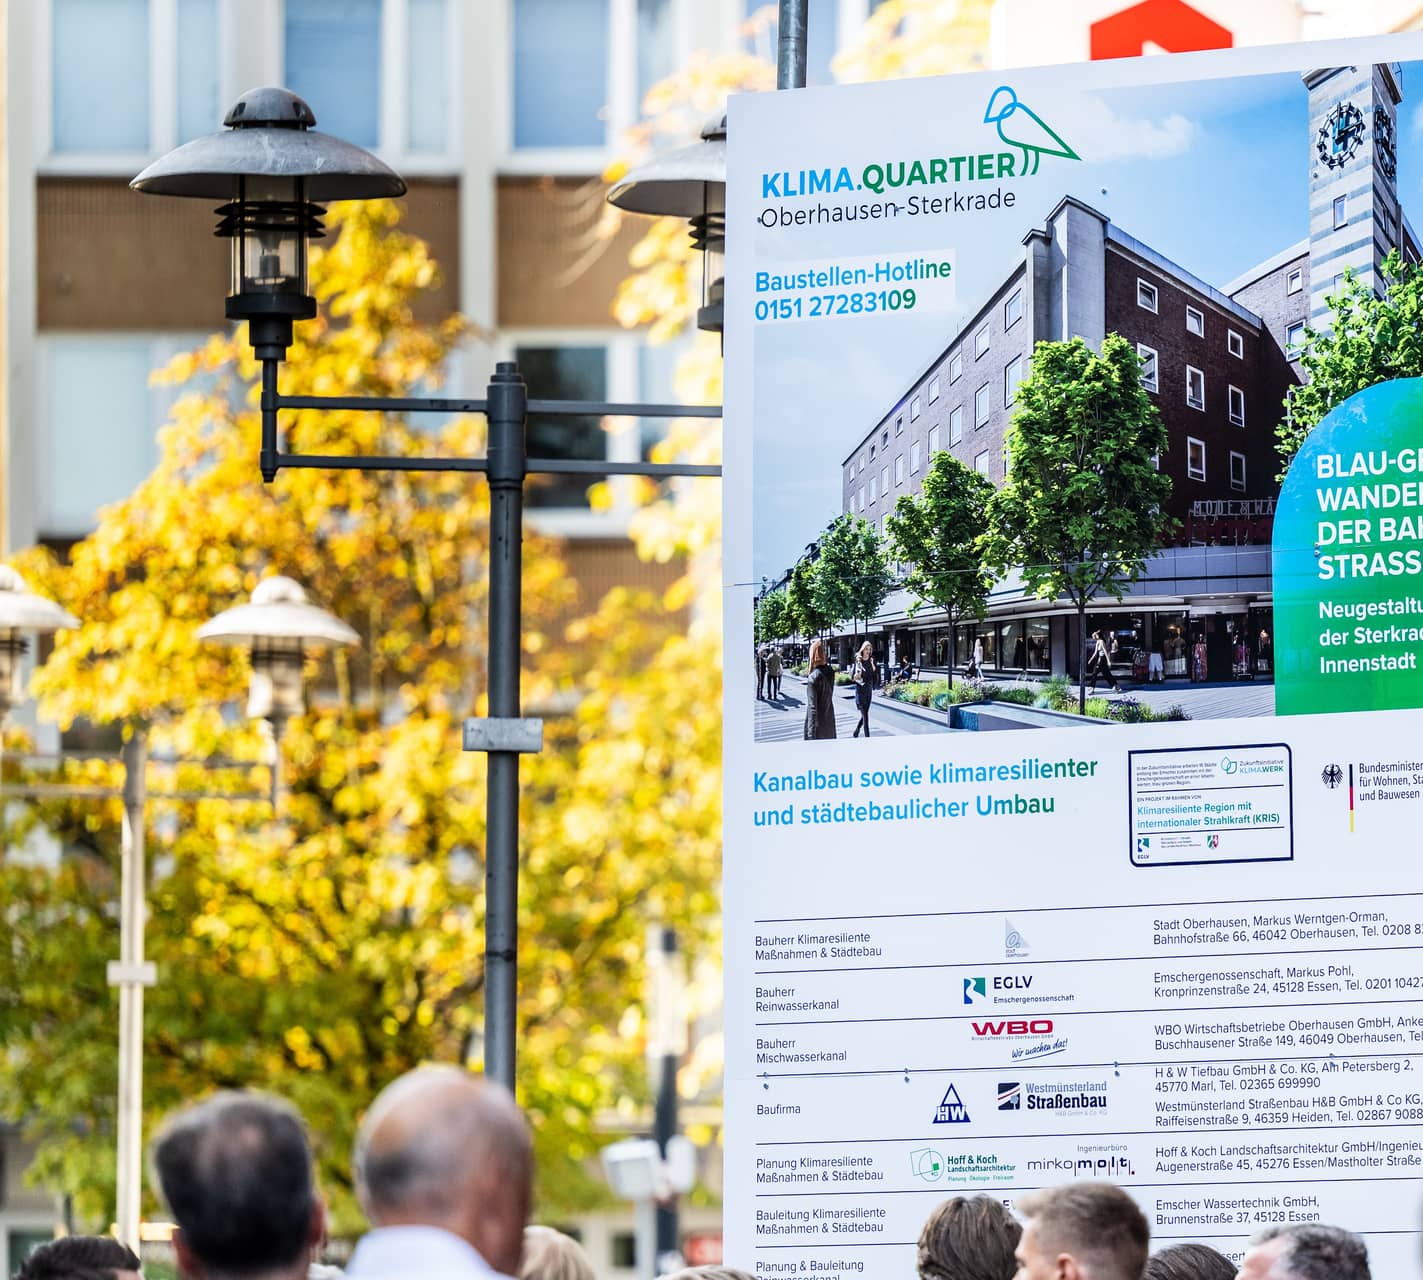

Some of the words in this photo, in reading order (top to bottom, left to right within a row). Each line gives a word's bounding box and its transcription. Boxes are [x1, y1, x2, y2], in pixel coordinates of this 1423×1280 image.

[762, 152, 1015, 198] KLIMA.QUARTIER
[761, 188, 1016, 228] Oberhausen-Sterkrade
[755, 258, 951, 292] Baustellen-Hotline
[755, 299, 802, 320] 0151
[809, 289, 917, 317] 27283109
[1318, 520, 1371, 547] DER
[1319, 628, 1349, 646] der
[1320, 651, 1416, 673] Innenstadt
[753, 769, 852, 792] Kanalbau
[860, 764, 922, 787] sowie
[929, 757, 1098, 784] klimaresilienter
[1359, 776, 1371, 787] für
[1372, 775, 1410, 786] Wohnen,
[1359, 789, 1375, 801] und
[1377, 789, 1419, 800] Bauwesen
[753, 804, 793, 826] und
[800, 797, 968, 824] städtebaulicher
[976, 793, 1054, 816] Umbau
[1137, 804, 1201, 815] Klimaresiliente
[1203, 802, 1234, 813] Region
[1237, 801, 1251, 810] mit
[1137, 817, 1201, 828] internationaler
[1203, 814, 1250, 825] Strahlkraft
[1252, 813, 1279, 824] (KRIS)
[1153, 919, 1180, 930] Stadt
[1182, 917, 1250, 929] Oberhausen,
[1253, 915, 1291, 926] Markus
[1293, 911, 1387, 926] Werntgen-Orman,
[755, 935, 794, 946] Bauherr
[797, 932, 870, 944] Klimaresiliente
[1153, 931, 1229, 944] Bahnhofstraße
[1232, 930, 1249, 942] 66,
[1252, 928, 1286, 940] 46042
[1290, 927, 1358, 939] Oberhausen,
[1361, 925, 1378, 936] Tel.
[1382, 923, 1411, 935] 0208
[755, 948, 817, 960] Maßnahmen
[820, 947, 827, 958] &
[830, 946, 881, 957] Städtebau
[1154, 967, 1283, 984] Emschergenossenschaft,
[1286, 967, 1325, 977] Markus
[1328, 964, 1353, 976] Pohl,
[993, 975, 1032, 989] EGLV
[1154, 982, 1249, 999] Kronprinzenstraße
[1252, 982, 1269, 994] 24,
[1272, 981, 1304, 993] 45128
[1307, 980, 1341, 992] Essen,
[1344, 979, 1362, 990] Tel.
[1365, 977, 1391, 989] 0201
[755, 986, 795, 997] Bauherr
[993, 993, 1074, 1004] Emschergenossenschaft
[755, 999, 839, 1011] Reinwasserkanal
[971, 1019, 1053, 1035] WBO
[1154, 1023, 1181, 1035] WBO
[1184, 1021, 1285, 1034] Wirtschaftsbetriebe
[1288, 1019, 1353, 1031] Oberhausen
[1357, 1016, 1393, 1028] GmbH,
[1396, 1016, 1423, 1027] Anke
[756, 1038, 795, 1049] Bauherr
[1155, 1038, 1235, 1050] Buschhausener
[1238, 1035, 1272, 1047] Straße
[1275, 1034, 1295, 1046] 149,
[1298, 1033, 1334, 1045] 46049
[1336, 1032, 1405, 1043] Oberhausen,
[756, 1050, 846, 1063] Mischwasserkanal
[1155, 1067, 1163, 1078] H
[1166, 1066, 1173, 1077] &
[1176, 1066, 1187, 1077] W
[1190, 1065, 1229, 1076] Tiefbau
[1232, 1063, 1265, 1075] GmbH
[1268, 1063, 1276, 1074] &
[1279, 1063, 1297, 1074] Co.
[1300, 1062, 1318, 1073] KG,
[1342, 1060, 1400, 1073] Petersberg
[1403, 1059, 1413, 1070] 2,
[1025, 1080, 1107, 1093] Westmünsterland
[1154, 1080, 1188, 1092] 45770
[1191, 1080, 1216, 1092] Marl,
[1219, 1079, 1236, 1090] Tel.
[1239, 1078, 1274, 1090] 02365
[1277, 1076, 1320, 1088] 699990
[1027, 1092, 1106, 1109] Straßenbau
[1154, 1099, 1245, 1112] Westmünsterland
[1248, 1097, 1308, 1109] Straßenbau
[1312, 1096, 1335, 1107] H&B
[1338, 1095, 1372, 1106] GmbH
[1375, 1094, 1383, 1105] &
[1386, 1094, 1401, 1105] Co
[1405, 1093, 1423, 1105] KG,
[756, 1103, 800, 1115] Baufirma
[1155, 1113, 1238, 1126] Raiffeisenstraße
[1241, 1113, 1251, 1124] 9,
[1254, 1112, 1288, 1123] 46359
[1291, 1111, 1332, 1122] Heiden,
[1335, 1110, 1353, 1121] Tel.
[1356, 1108, 1391, 1120] 02867
[1077, 1143, 1127, 1153] Ingenieurbüro
[1155, 1146, 1178, 1157] Hoff
[1180, 1145, 1187, 1157] &
[1191, 1145, 1216, 1156] Koch
[1220, 1142, 1338, 1156] Landschaftsarchitektur
[756, 1158, 797, 1170] Planung
[799, 1156, 873, 1167] Klimaresiliente
[947, 1154, 966, 1164] Hoff
[967, 1154, 974, 1164] &
[976, 1154, 997, 1164] Koch
[1155, 1159, 1233, 1174] Augenerstraße
[1236, 1158, 1252, 1170] 45,
[1255, 1157, 1289, 1169] 45276
[1292, 1156, 1383, 1168] Essen/Mastholter
[1386, 1154, 1421, 1166] Straße
[947, 1164, 1015, 1172] Landschaftsarchitektur
[756, 1169, 818, 1183] Maßnahmen
[821, 1170, 828, 1181] &
[831, 1169, 883, 1181] Städtebau
[1156, 1199, 1200, 1210] Emscher
[1203, 1196, 1279, 1209] Wassertechnik
[1282, 1195, 1319, 1207] GmbH,
[756, 1209, 809, 1222] Bauleitung
[812, 1207, 885, 1219] Klimaresiliente
[1156, 1212, 1233, 1224] Brunnenstraße
[1236, 1211, 1250, 1223] 37,
[1253, 1210, 1285, 1222] 45128
[1288, 1210, 1320, 1222] Essen
[756, 1223, 818, 1234] Maßnahmen
[821, 1222, 828, 1233] &
[831, 1221, 883, 1232] Städtebau
[756, 1261, 796, 1274] Planung
[799, 1260, 806, 1271] &
[810, 1259, 863, 1272] Bauleitung
